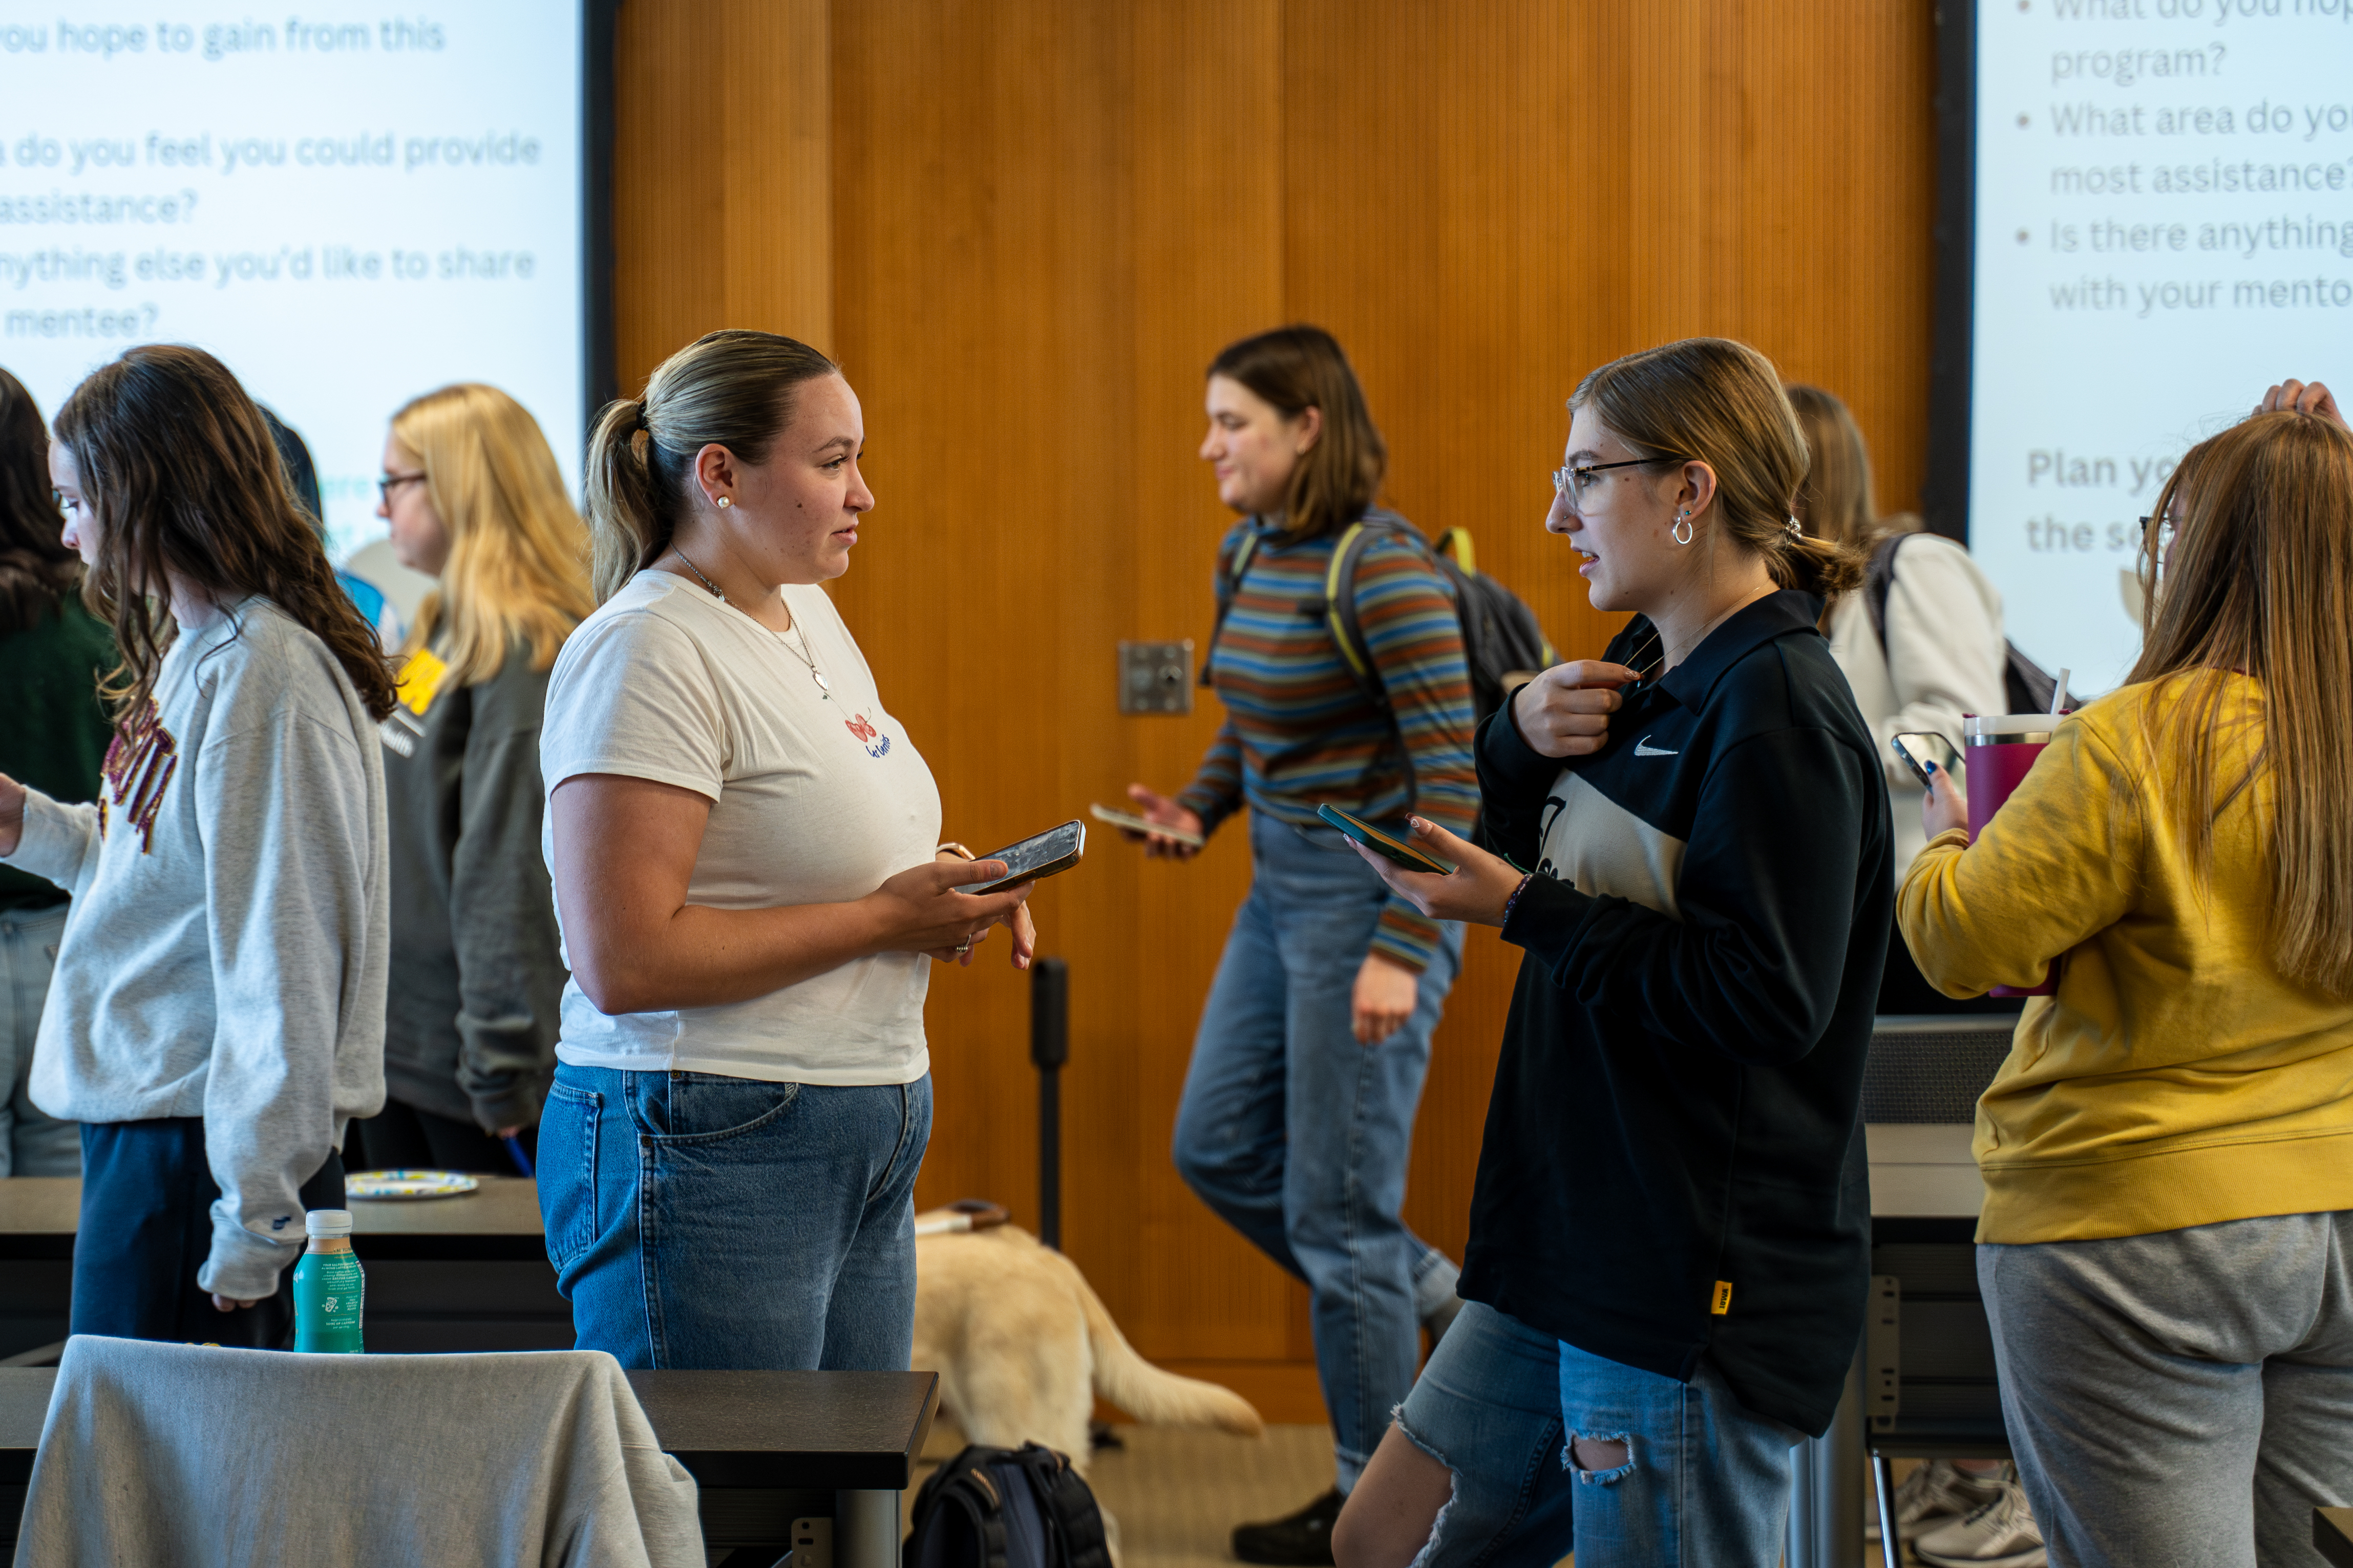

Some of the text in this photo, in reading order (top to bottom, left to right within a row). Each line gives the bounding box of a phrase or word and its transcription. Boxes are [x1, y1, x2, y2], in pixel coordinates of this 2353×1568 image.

[0, 14, 447, 62] ou hope to gain from this
[2050, 41, 2227, 87] program?
[2050, 100, 2148, 137] What
[2156, 105, 2236, 135] area
[2246, 97, 2293, 134] do
[14, 129, 62, 167] do
[68, 137, 136, 176] you
[144, 129, 213, 167] feel
[219, 138, 287, 176] you
[295, 128, 396, 167] could
[405, 128, 543, 172] provide
[2050, 161, 2144, 195] most
[2051, 218, 2079, 253] Is
[2090, 216, 2188, 252] there
[134, 244, 206, 281] else
[322, 244, 383, 280] like
[391, 249, 430, 280] to
[437, 244, 536, 280] share
[2050, 274, 2128, 310] with
[2137, 280, 2222, 318] your
[4, 301, 159, 338] mentee?
[2027, 447, 2117, 487] Plan
[2024, 513, 2095, 552] the
[1719, 1288, 1729, 1309] IOWA
